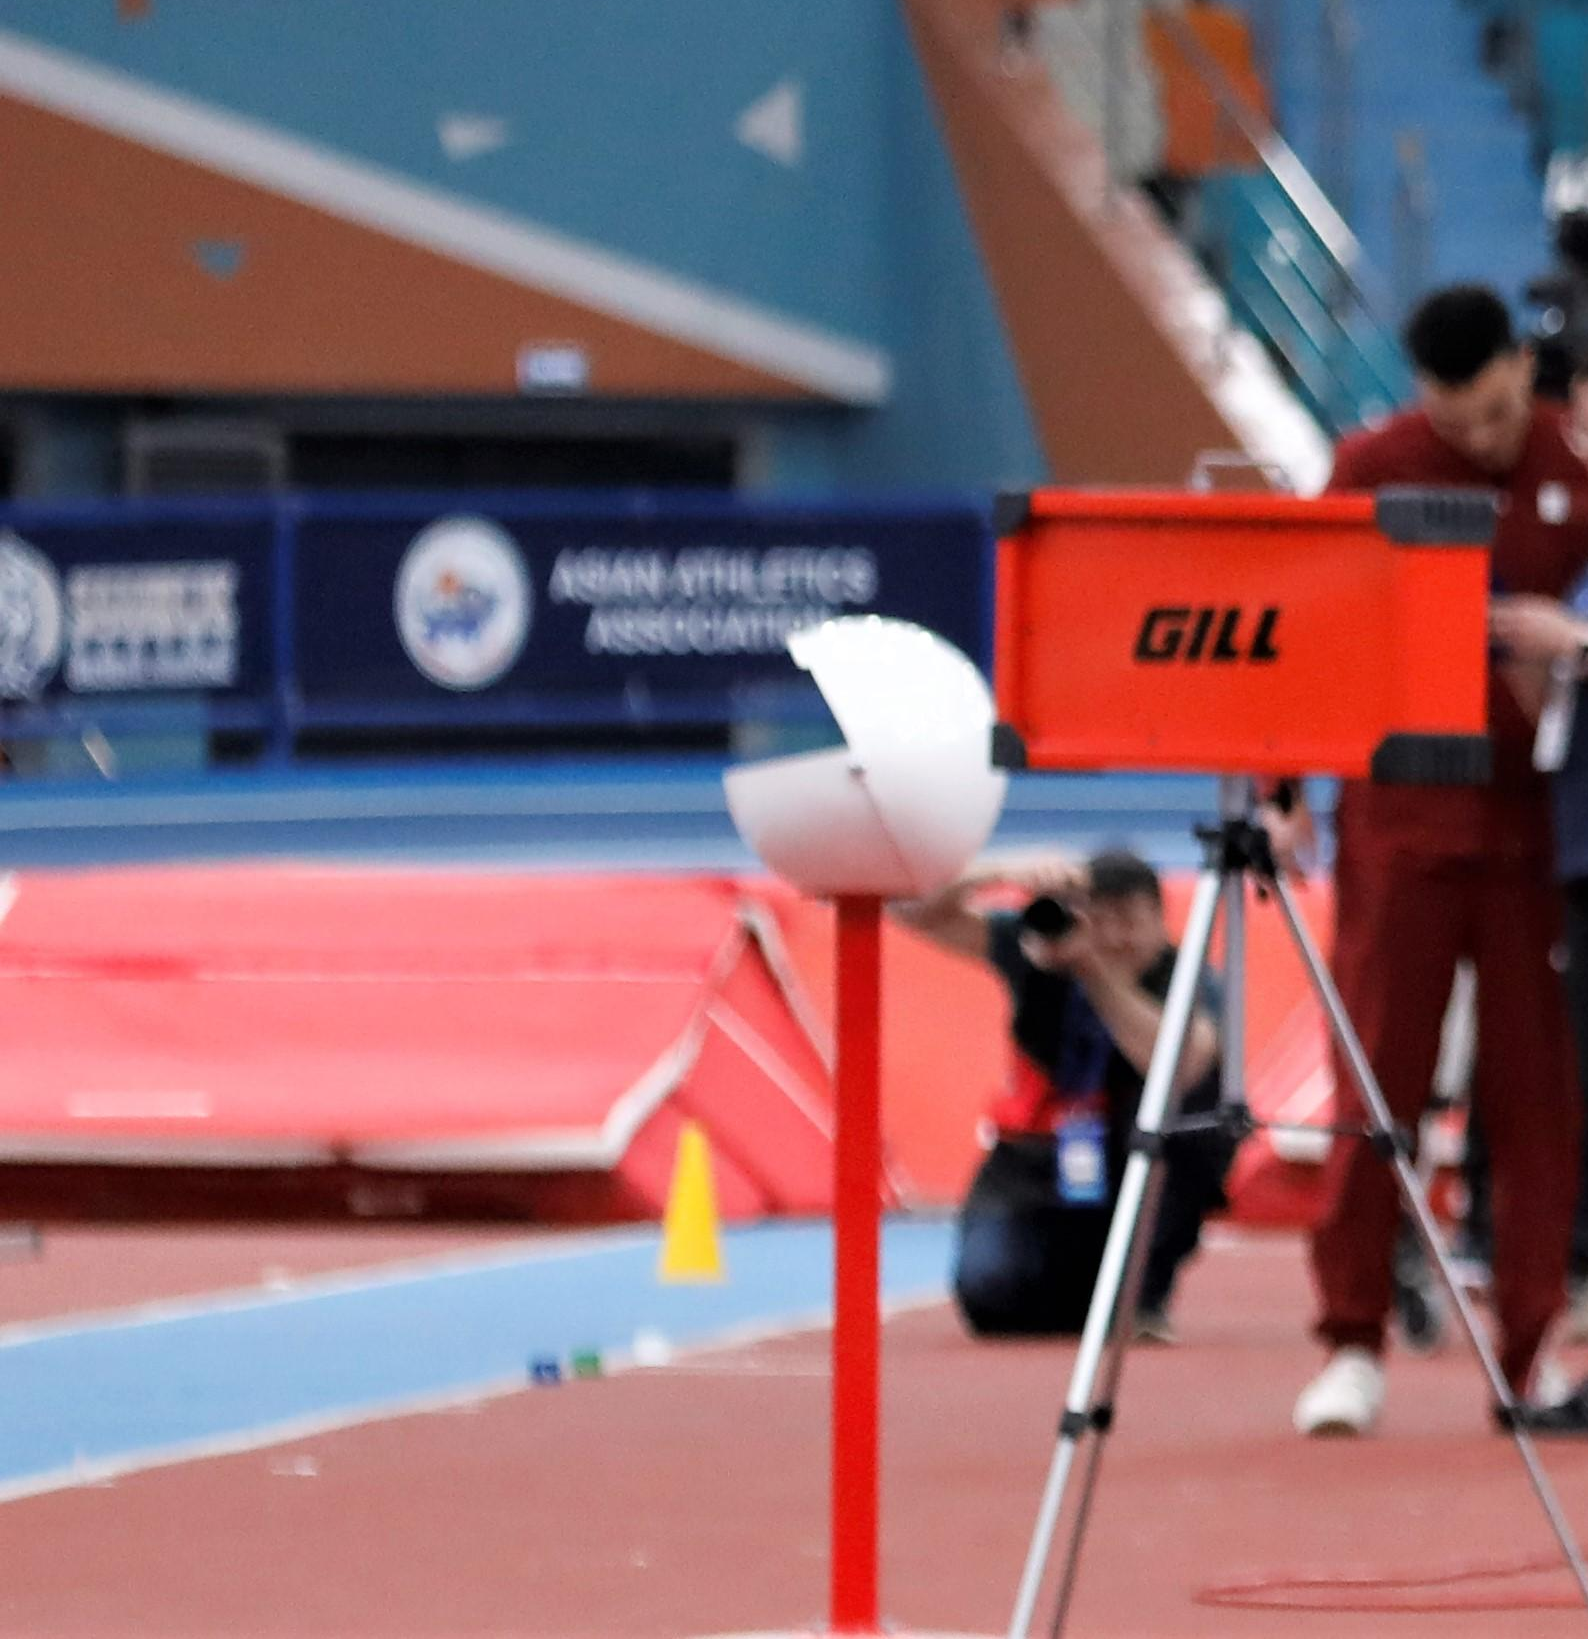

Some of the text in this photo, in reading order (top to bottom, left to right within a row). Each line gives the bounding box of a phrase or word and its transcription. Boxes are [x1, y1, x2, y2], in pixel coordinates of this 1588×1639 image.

[550, 546, 880, 603] ASIAN ATHLETICS
[1132, 605, 1284, 664] GILL
